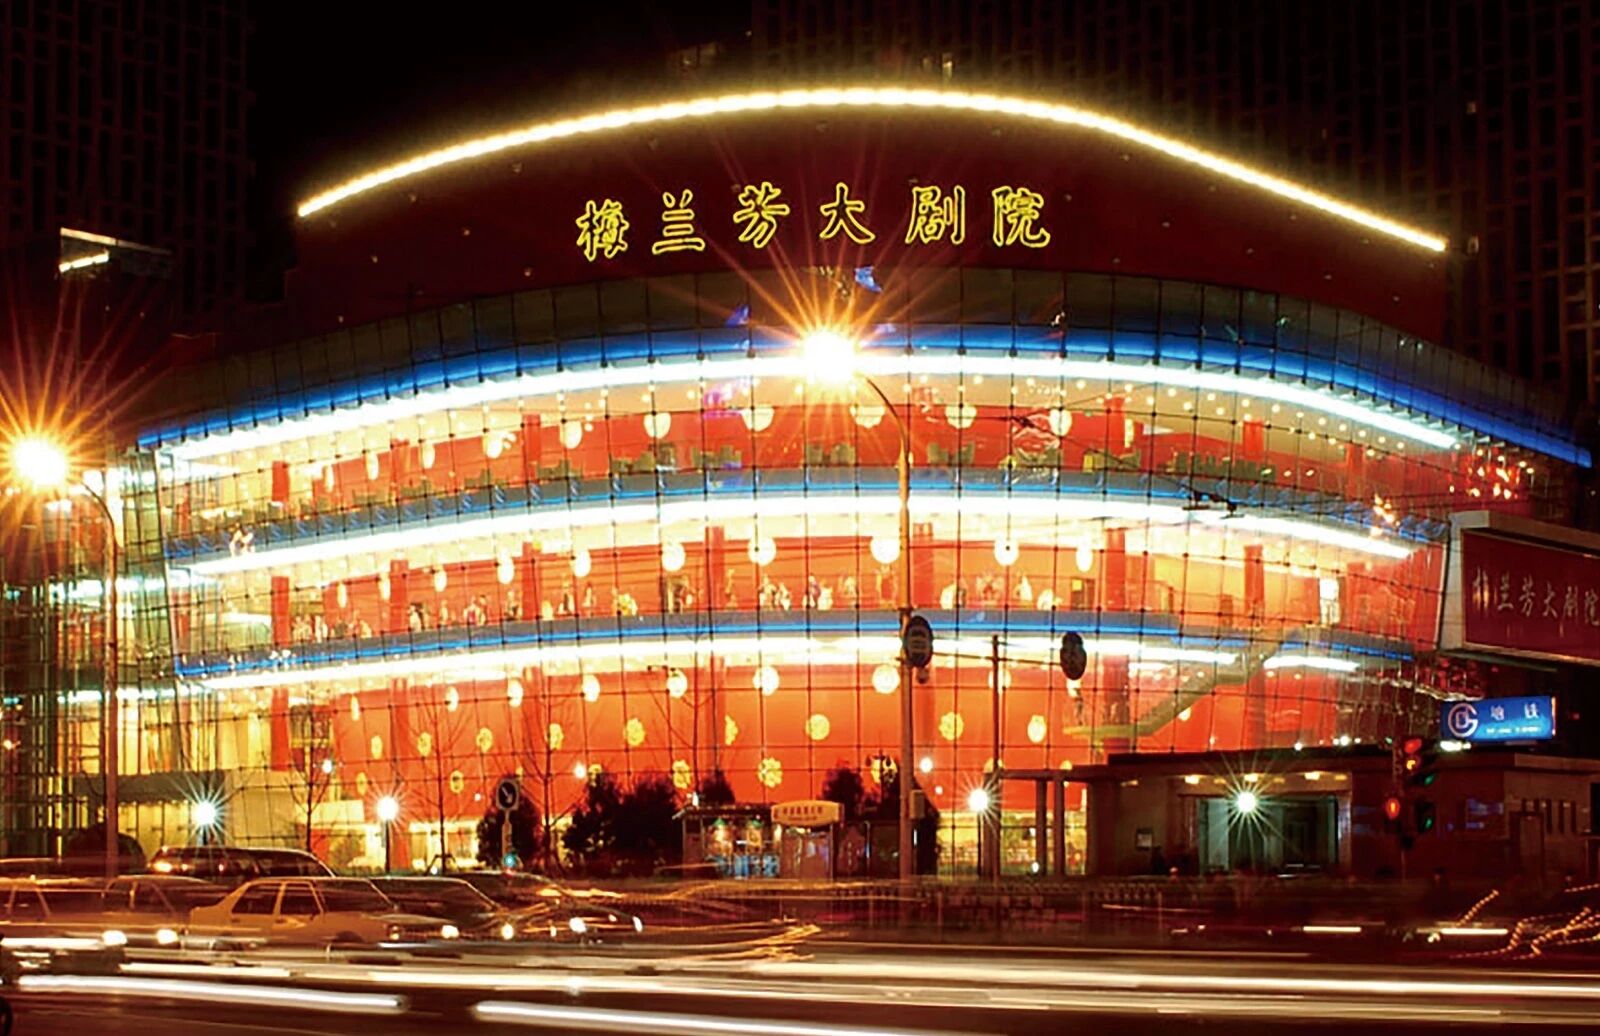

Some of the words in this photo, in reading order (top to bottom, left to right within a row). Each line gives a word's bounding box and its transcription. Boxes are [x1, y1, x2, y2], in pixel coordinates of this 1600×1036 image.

[575, 181, 1051, 262] 梅兰芳大剧院
